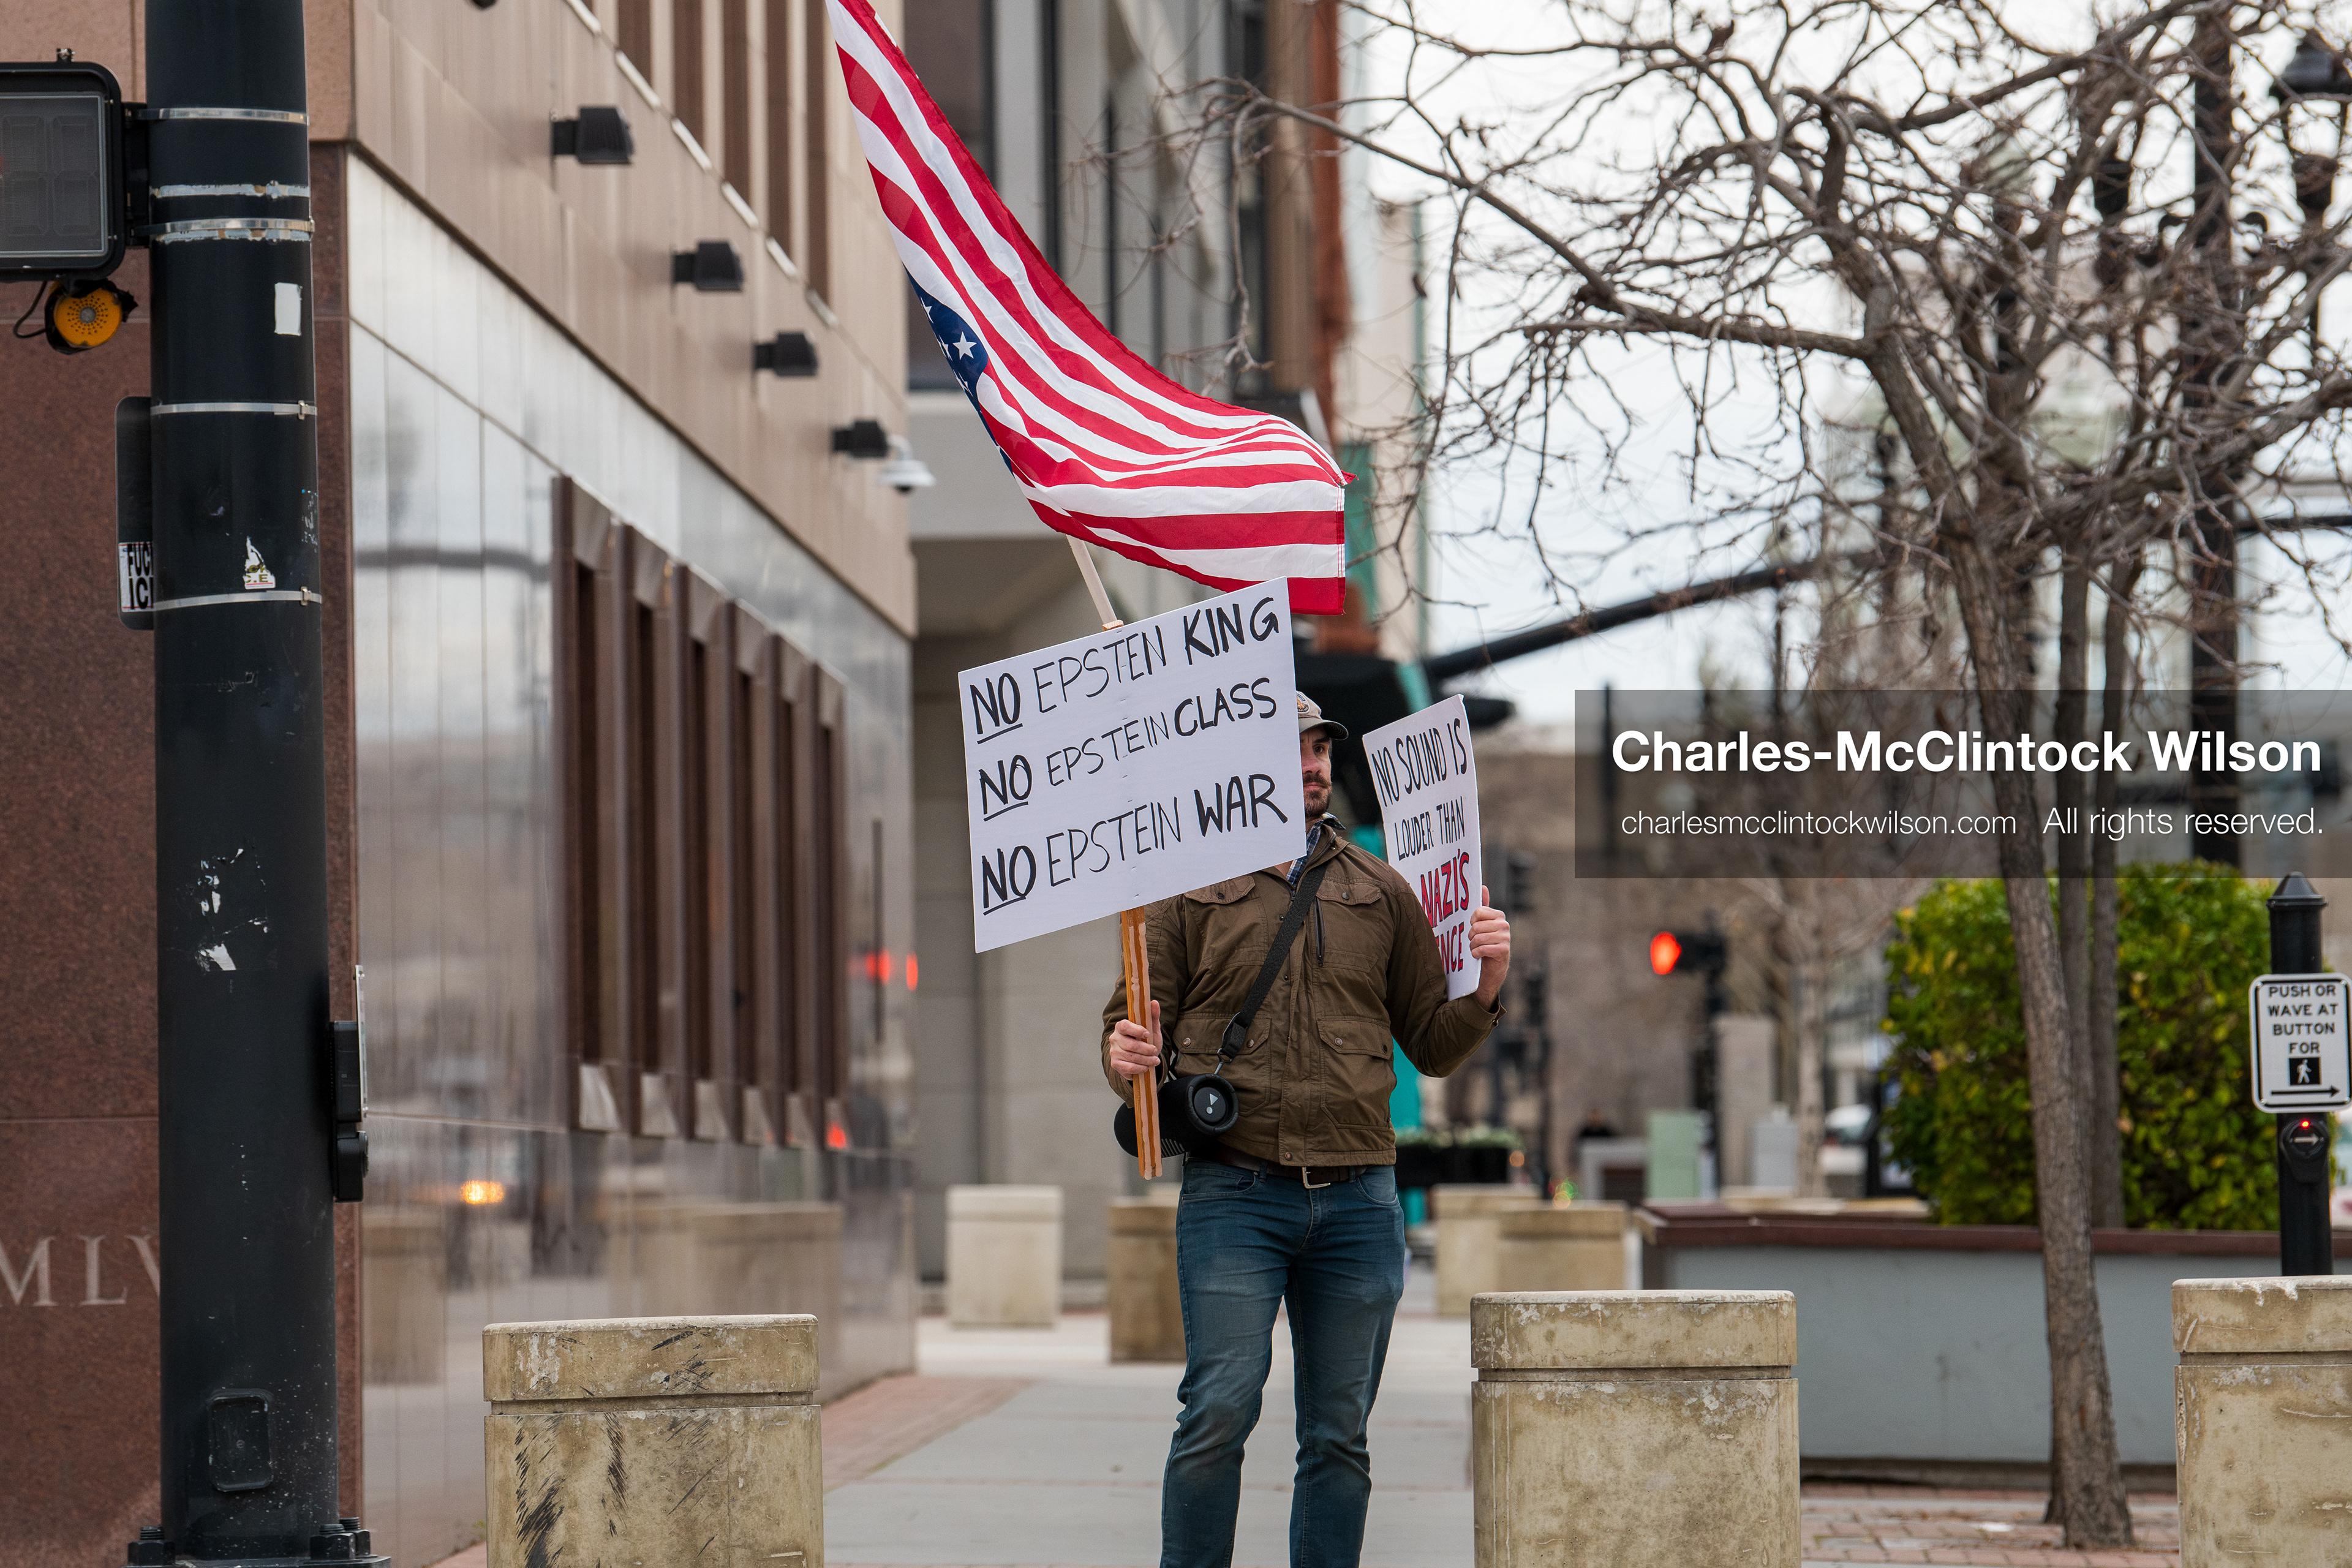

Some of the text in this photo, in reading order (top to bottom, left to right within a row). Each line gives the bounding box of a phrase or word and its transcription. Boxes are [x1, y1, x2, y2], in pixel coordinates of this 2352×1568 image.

[127, 543, 154, 577] FUC
[129, 577, 154, 609] IC
[969, 596, 1280, 736] NO EPSTEN KING
[978, 676, 1278, 816] NO EPSTEIN CLASS
[1371, 717, 1468, 808] NO SOUND IS
[981, 773, 1289, 910] NO EPSTEIN WAR
[1393, 795, 1466, 862] LOUDER THAN
[1420, 848, 1470, 929] NAZI'S
[1434, 921, 1465, 975] NCE
[2267, 1003, 2339, 1017] WAVE AT
[2269, 984, 2336, 998] PUSH OR
[2273, 1022, 2335, 1036] BUTTON
[2289, 1042, 2320, 1054] FOR
